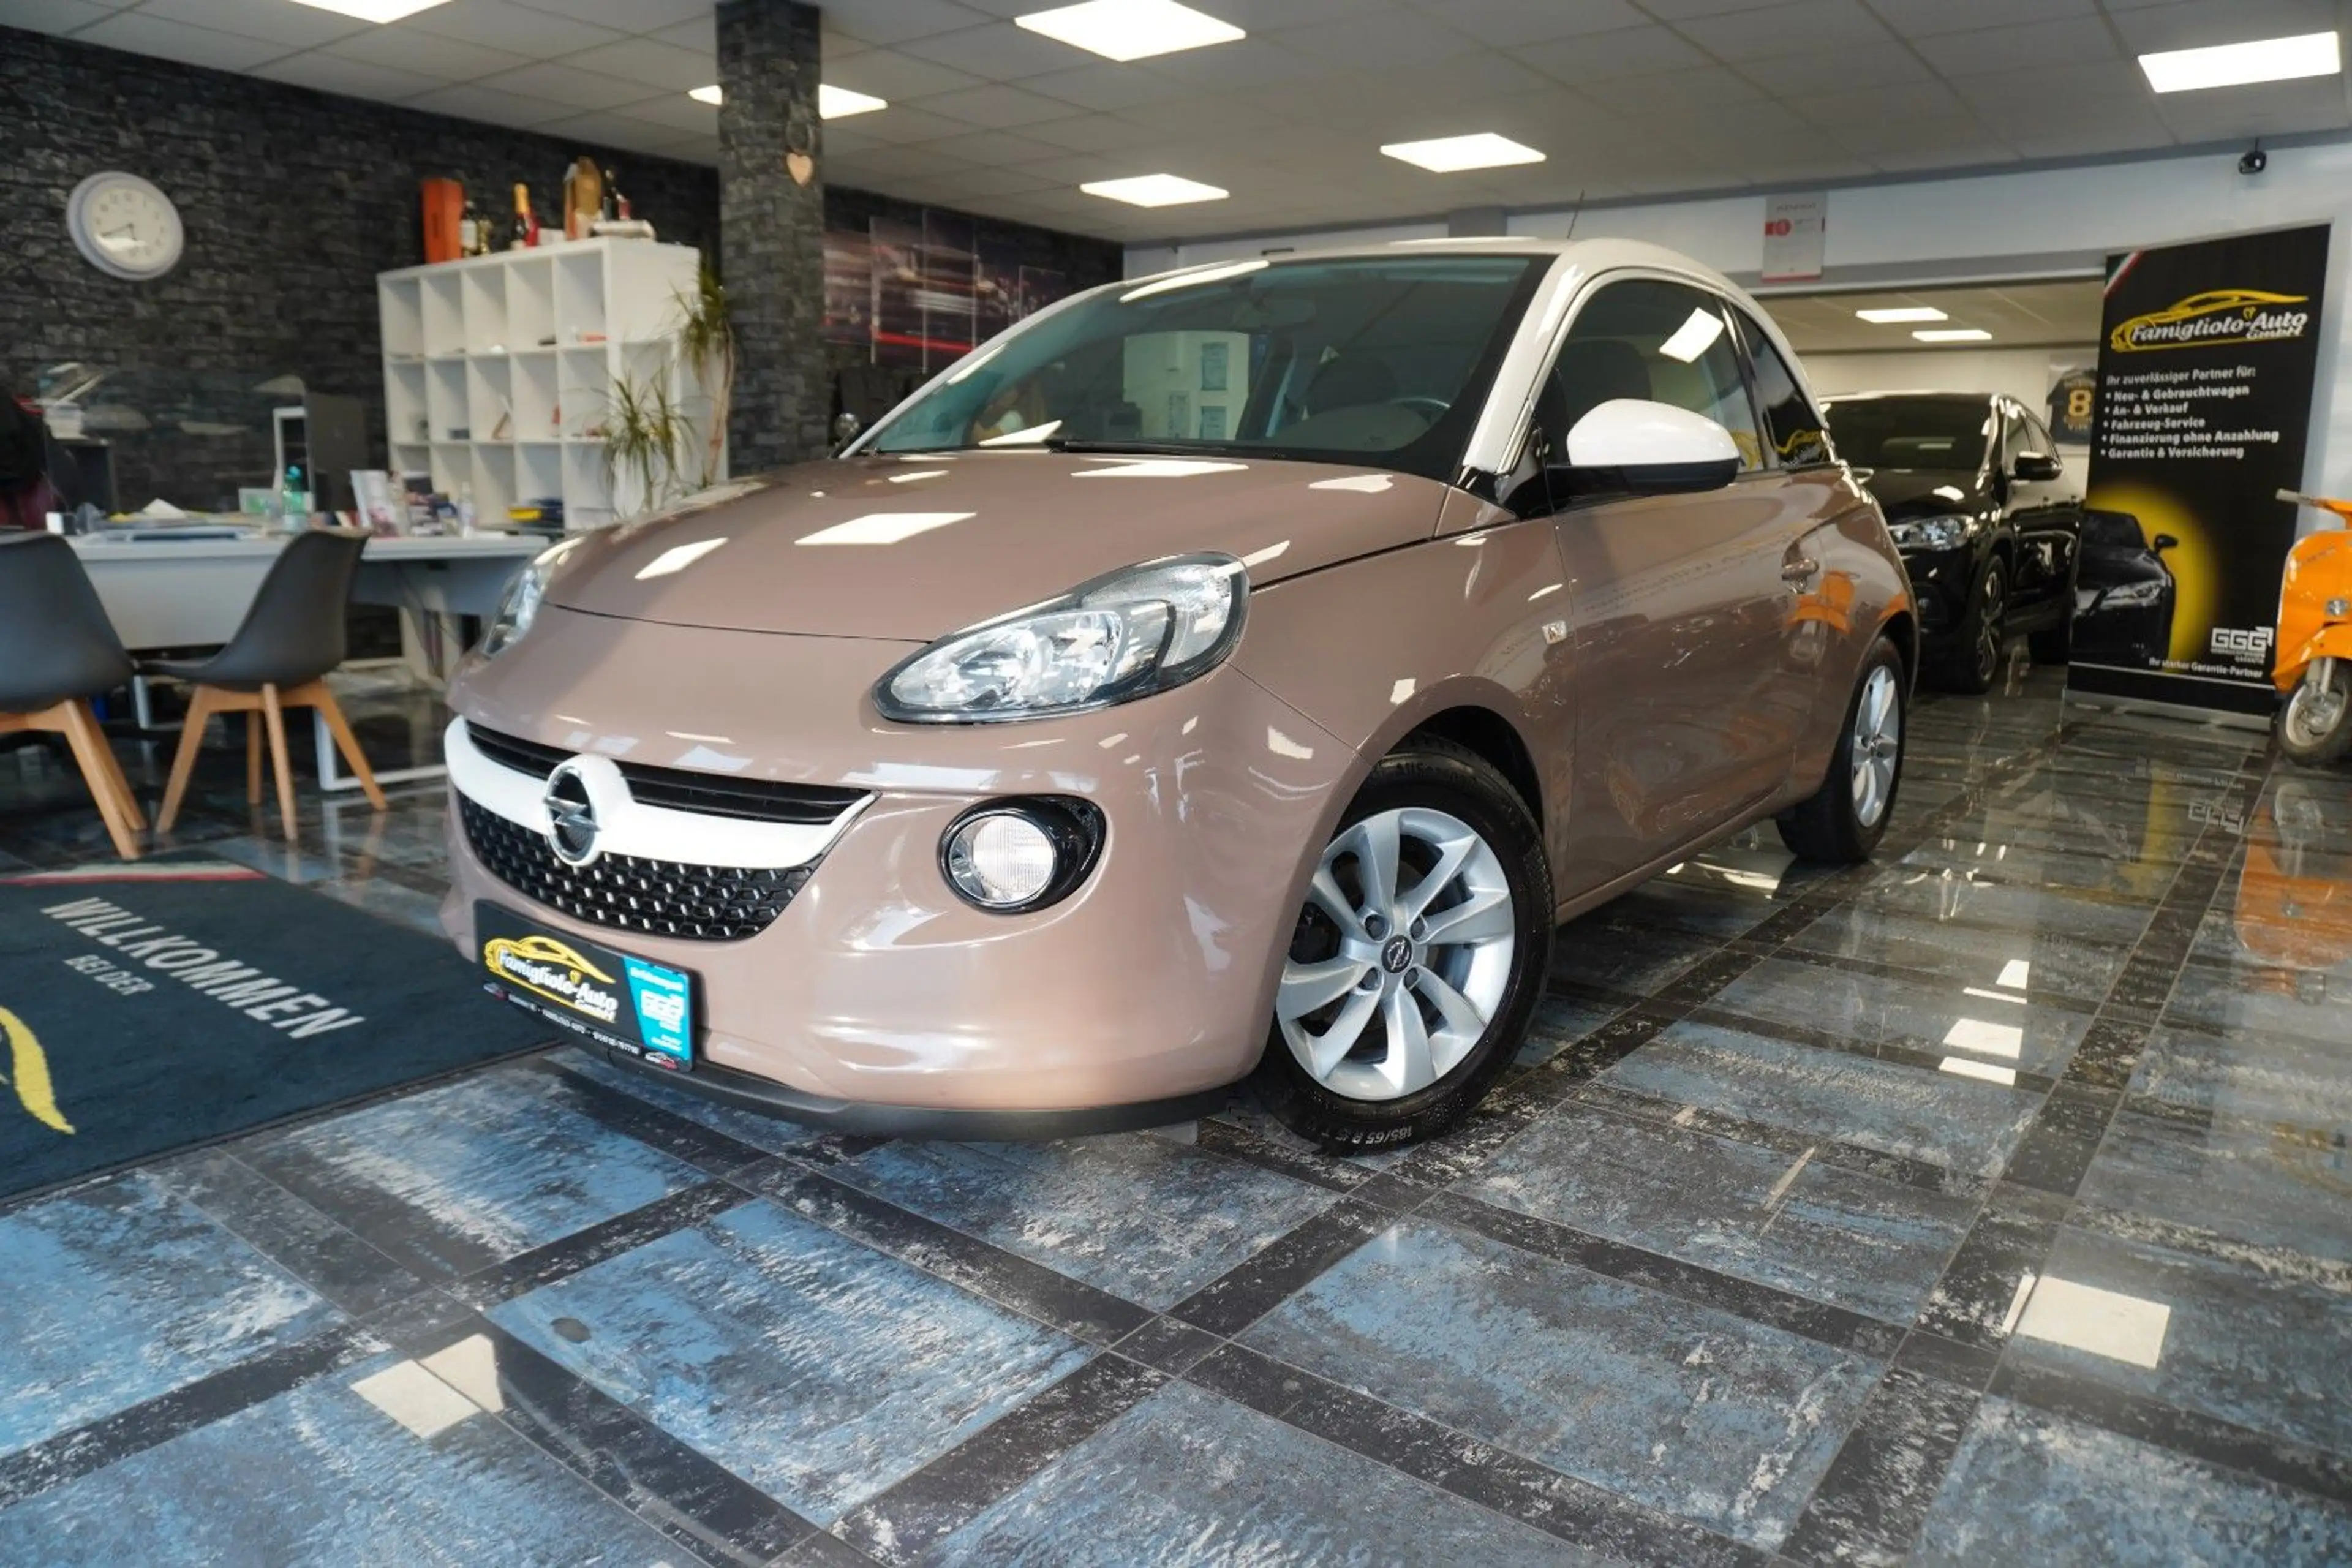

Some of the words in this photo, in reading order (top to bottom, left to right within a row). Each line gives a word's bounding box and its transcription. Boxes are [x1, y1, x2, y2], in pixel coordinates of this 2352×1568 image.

[2106, 375, 2120, 386] Ihr
[2122, 371, 2190, 385] zuverlässiger
[2192, 368, 2234, 382] Partner
[2236, 365, 2256, 379] für:
[2114, 390, 2139, 402] Neu-
[2141, 389, 2150, 401] &
[2152, 385, 2250, 400] Gebrauchtwagen
[2068, 390, 2091, 417] 8
[2113, 405, 2131, 416] An-
[2133, 404, 2142, 415] &
[2145, 401, 2189, 415] Verkauf
[2111, 416, 2206, 432] Fahrzeug-Service
[2109, 431, 2180, 445] Finanzierung
[2182, 431, 2212, 443] ohne
[2214, 429, 2280, 443] Anzahlung
[2108, 447, 2155, 459] Garantie
[2157, 446, 2166, 458] &
[2168, 444, 2245, 460] Versicherung
[2211, 627, 2270, 650] GGG
[2191, 662, 2264, 679] Garantie-Partner
[40, 896, 366, 1039] WILLKOMMEN
[63, 954, 118, 974] BEI
[94, 971, 156, 995] DER
[1365, 1126, 1412, 1144] 185/65
